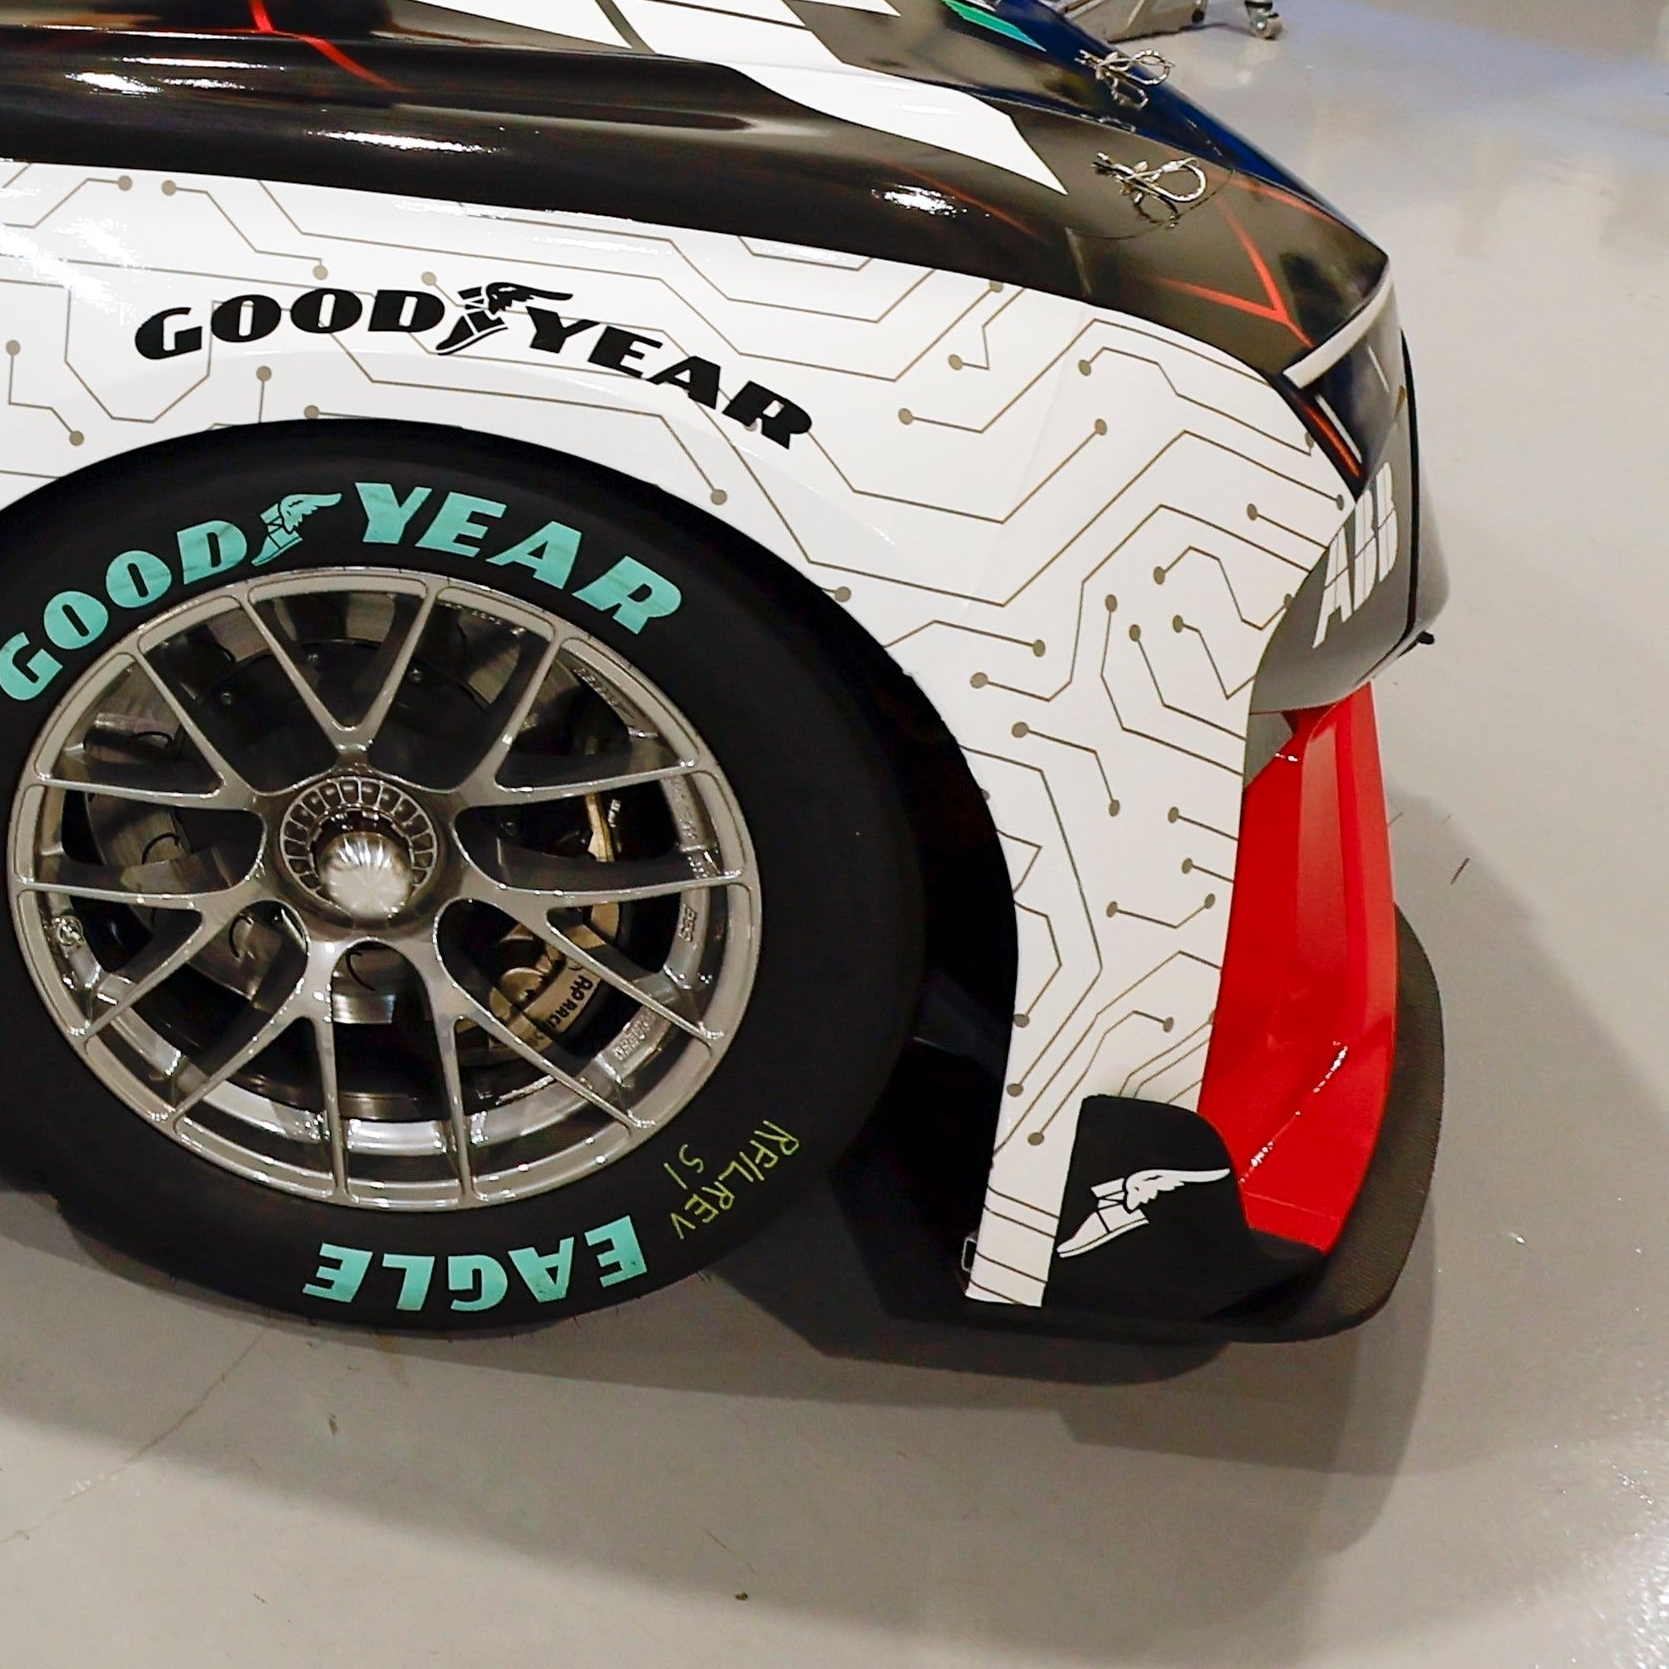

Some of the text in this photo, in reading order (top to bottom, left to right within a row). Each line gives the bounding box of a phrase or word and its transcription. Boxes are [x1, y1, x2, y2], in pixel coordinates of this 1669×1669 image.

[134, 283, 813, 451] GOODYEAR
[1312, 461, 1399, 650] ABB
[302, 1215, 649, 1313] EAGLE
